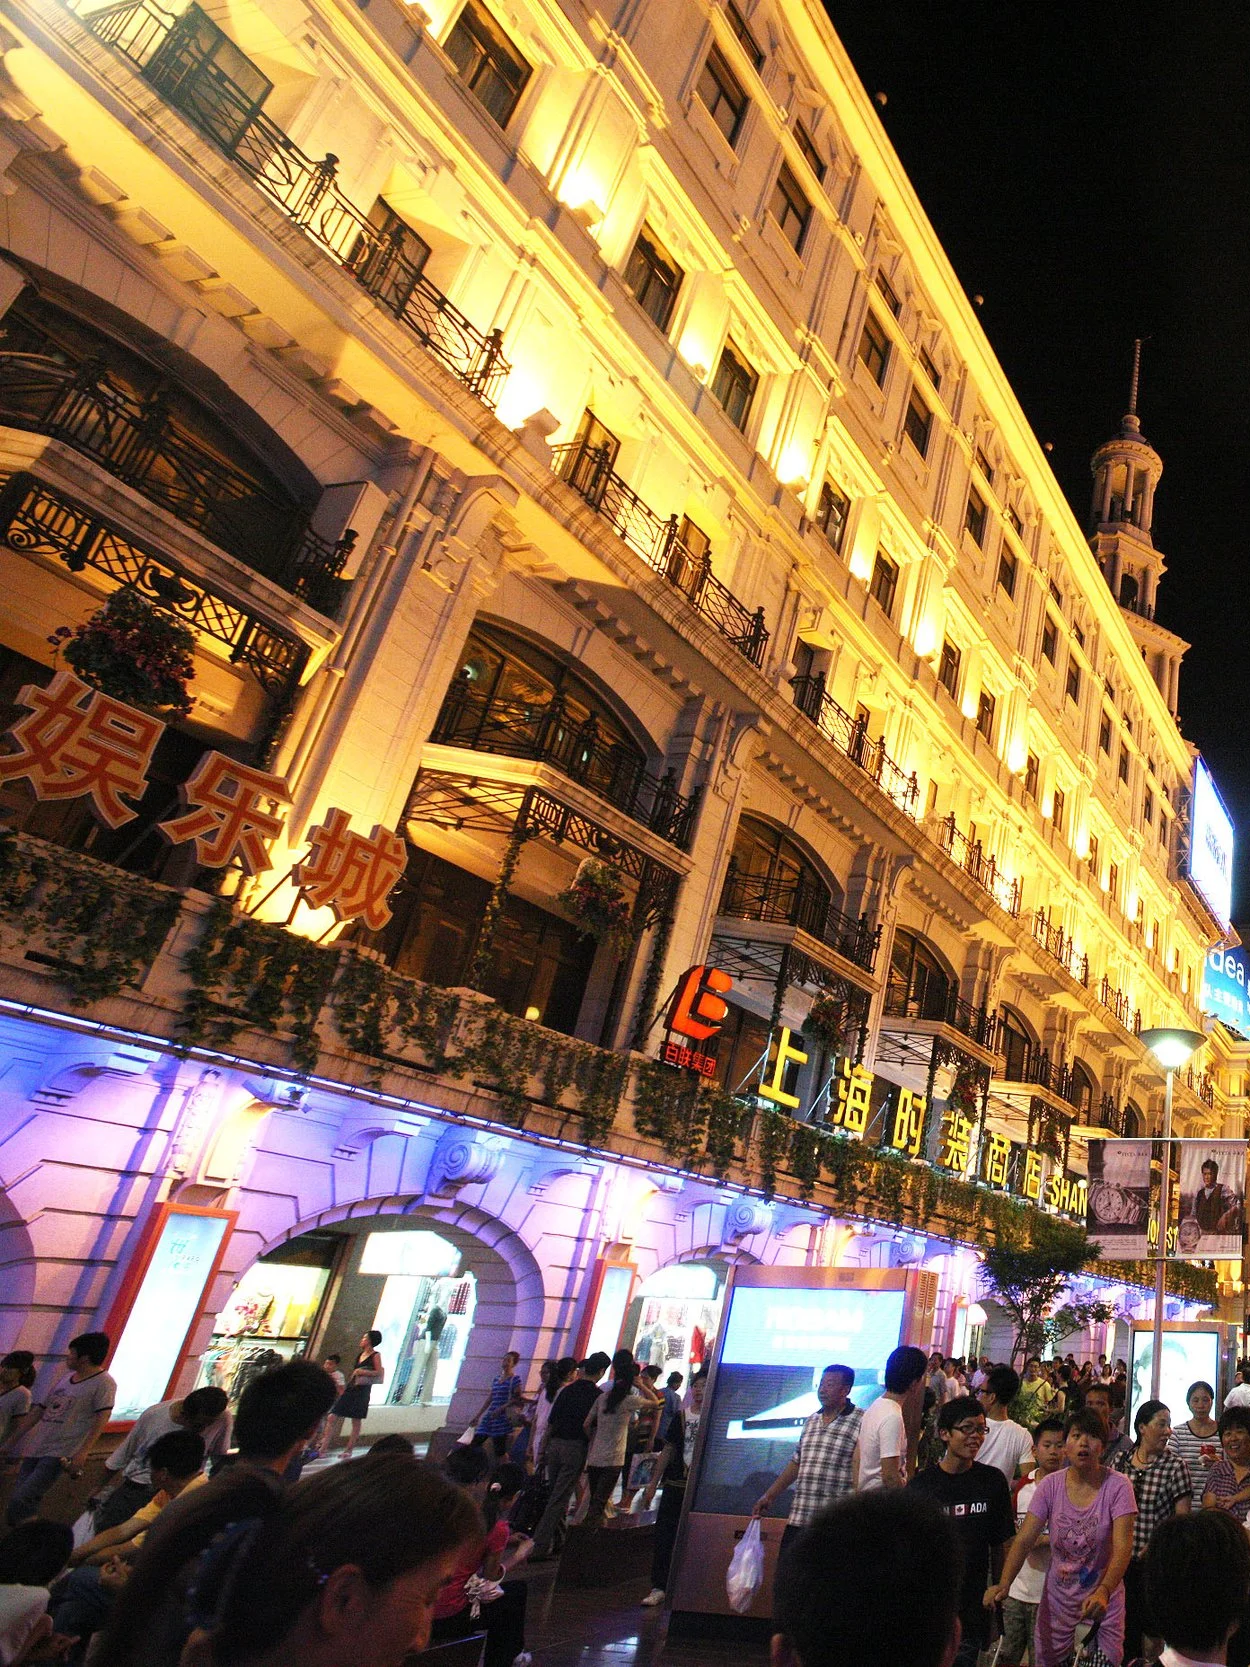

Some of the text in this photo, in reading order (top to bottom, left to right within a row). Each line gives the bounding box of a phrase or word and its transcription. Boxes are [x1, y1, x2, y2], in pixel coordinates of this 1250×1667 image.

[0, 671, 409, 931] 娱乐城
[1204, 947, 1245, 987] dea
[664, 1042, 717, 1077] 百联集团
[758, 1026, 1043, 1200] 上海时装商店
[1050, 1176, 1088, 1217] SHAN
